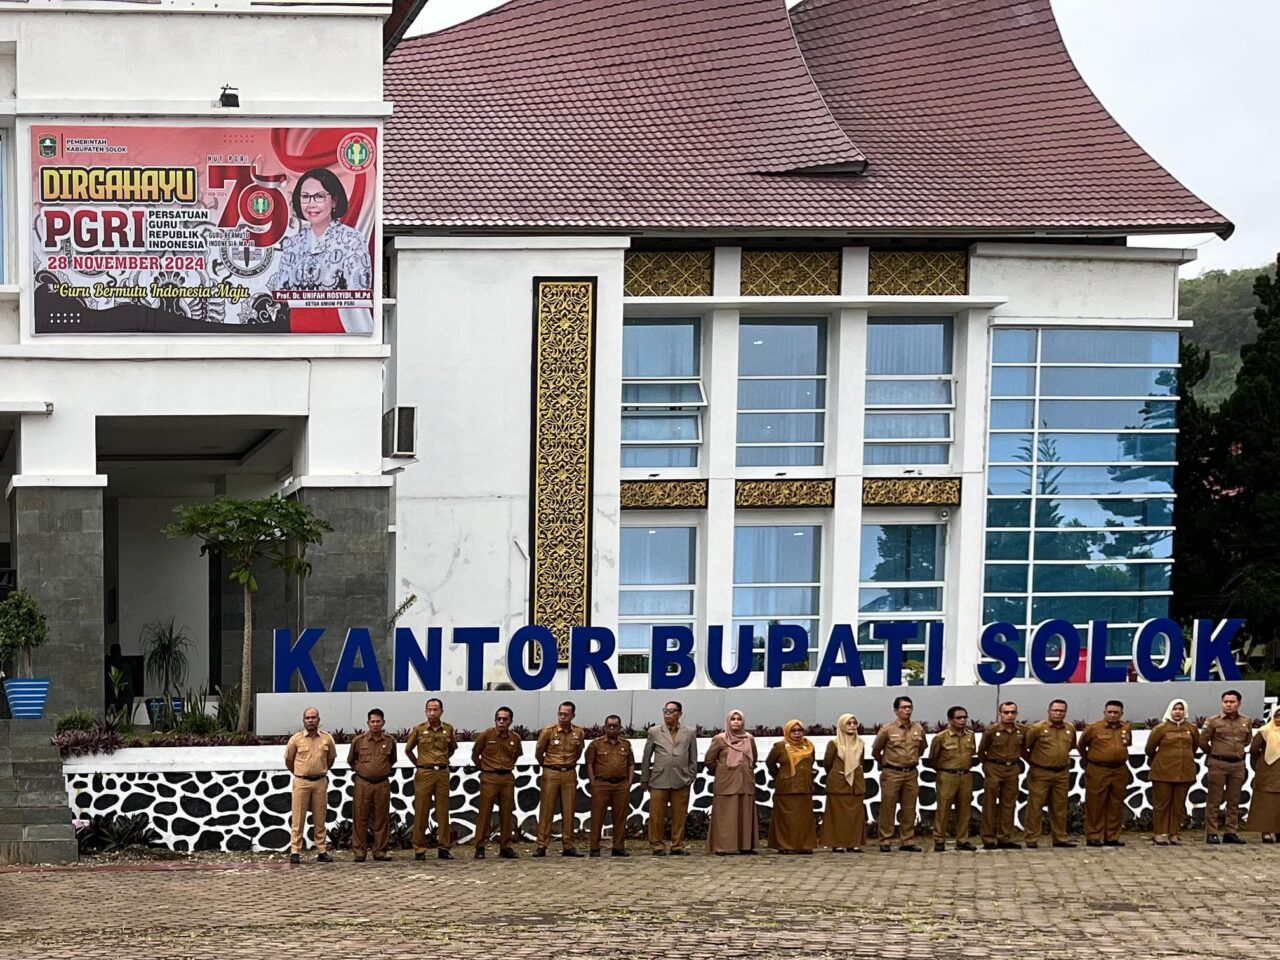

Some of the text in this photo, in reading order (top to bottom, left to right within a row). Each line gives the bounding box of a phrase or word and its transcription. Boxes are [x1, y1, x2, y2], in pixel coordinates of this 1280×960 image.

[43, 168, 194, 202] DIRGAHAYU
[208, 165, 289, 248] 79
[148, 210, 208, 220] PERSATUAN
[44, 210, 145, 248] PGRI
[148, 220, 178, 230] GURU
[148, 231, 200, 240] REPUBLIK
[148, 240, 205, 249] INDONESIA
[48, 256, 68, 270] 28
[73, 256, 160, 270] NOVEMBER
[165, 256, 205, 270] 2024
[94, 284, 147, 298] Bermutu
[150, 284, 212, 298] Indonesia
[215, 284, 250, 300] Maju
[271, 618, 1246, 693] KANTOR BUPATI SOLOK
